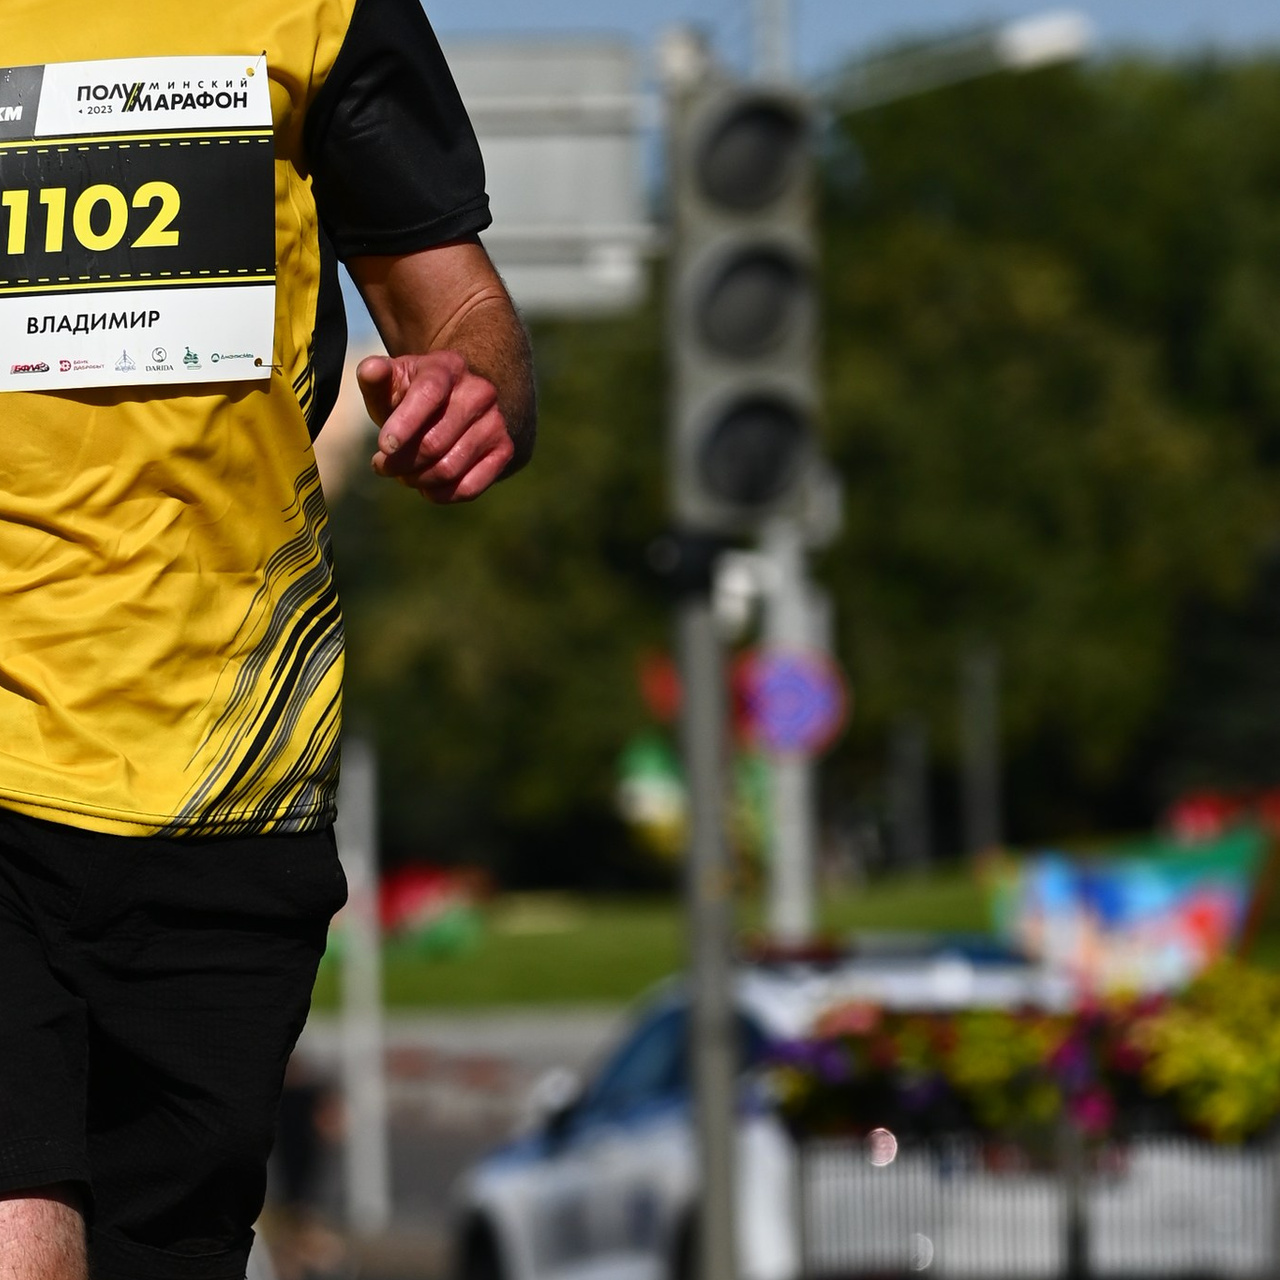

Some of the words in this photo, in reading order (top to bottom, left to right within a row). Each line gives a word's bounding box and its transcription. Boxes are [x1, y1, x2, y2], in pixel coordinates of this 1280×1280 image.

[148, 77, 249, 91] МИНСКИЙ
[77, 82, 145, 113] ПОЛУ
[129, 91, 249, 113] МАРАФОН
[86, 105, 114, 116] 2023
[1, 180, 181, 256] 1102
[26, 310, 161, 336] ВЛАДИМИР
[145, 363, 175, 372] DARIDA
